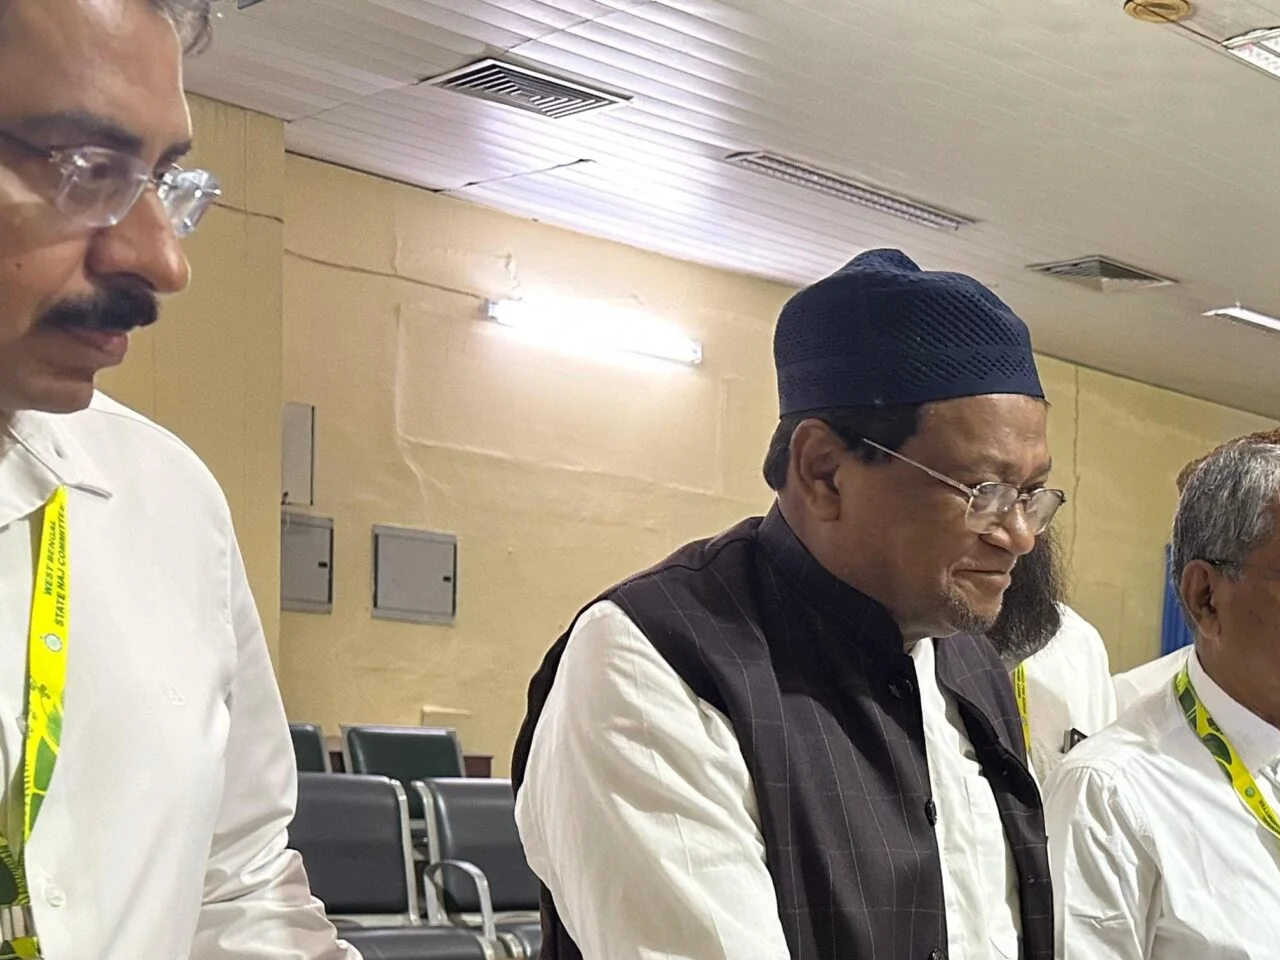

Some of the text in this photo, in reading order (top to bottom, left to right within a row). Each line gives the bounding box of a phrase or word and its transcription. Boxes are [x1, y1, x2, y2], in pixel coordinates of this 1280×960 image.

[43, 520, 56, 596] WEST BENGAL
[56, 568, 65, 591] HAJ
[54, 592, 65, 627] STATE
